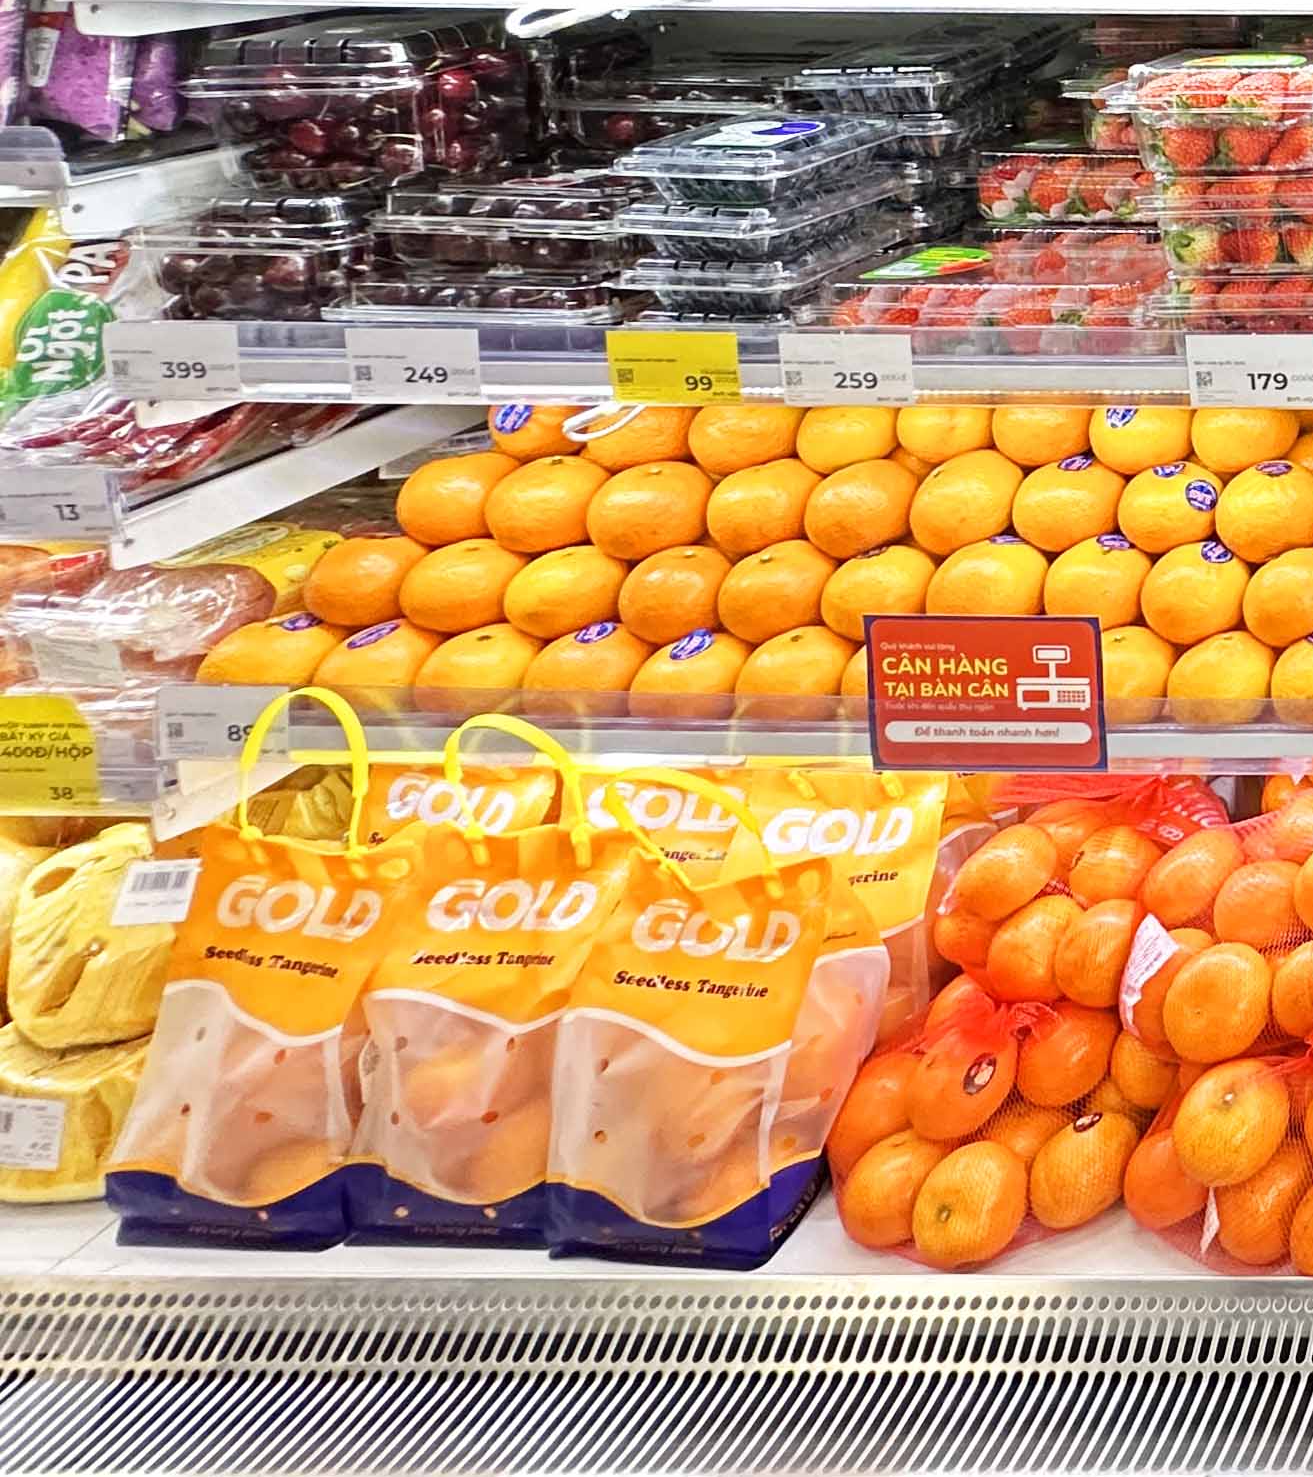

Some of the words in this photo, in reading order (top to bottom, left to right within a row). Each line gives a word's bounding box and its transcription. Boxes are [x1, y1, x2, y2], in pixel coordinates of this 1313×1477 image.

[160, 362, 207, 379] 399
[403, 367, 448, 383] 249
[685, 376, 712, 391] 99
[834, 372, 878, 389] 259
[1247, 373, 1288, 390] 179
[54, 504, 81, 521] 13
[882, 652, 931, 676] CÂN
[939, 653, 1009, 676] HÀNG
[884, 682, 915, 700] TẠI
[920, 679, 962, 697] BÀN
[967, 678, 1009, 698] CÂN
[50, 786, 74, 800] 38
[762, 807, 915, 856] GOLD
[217, 875, 383, 943] GOLD
[425, 878, 598, 932] GOLD
[632, 898, 800, 963] GOLD
